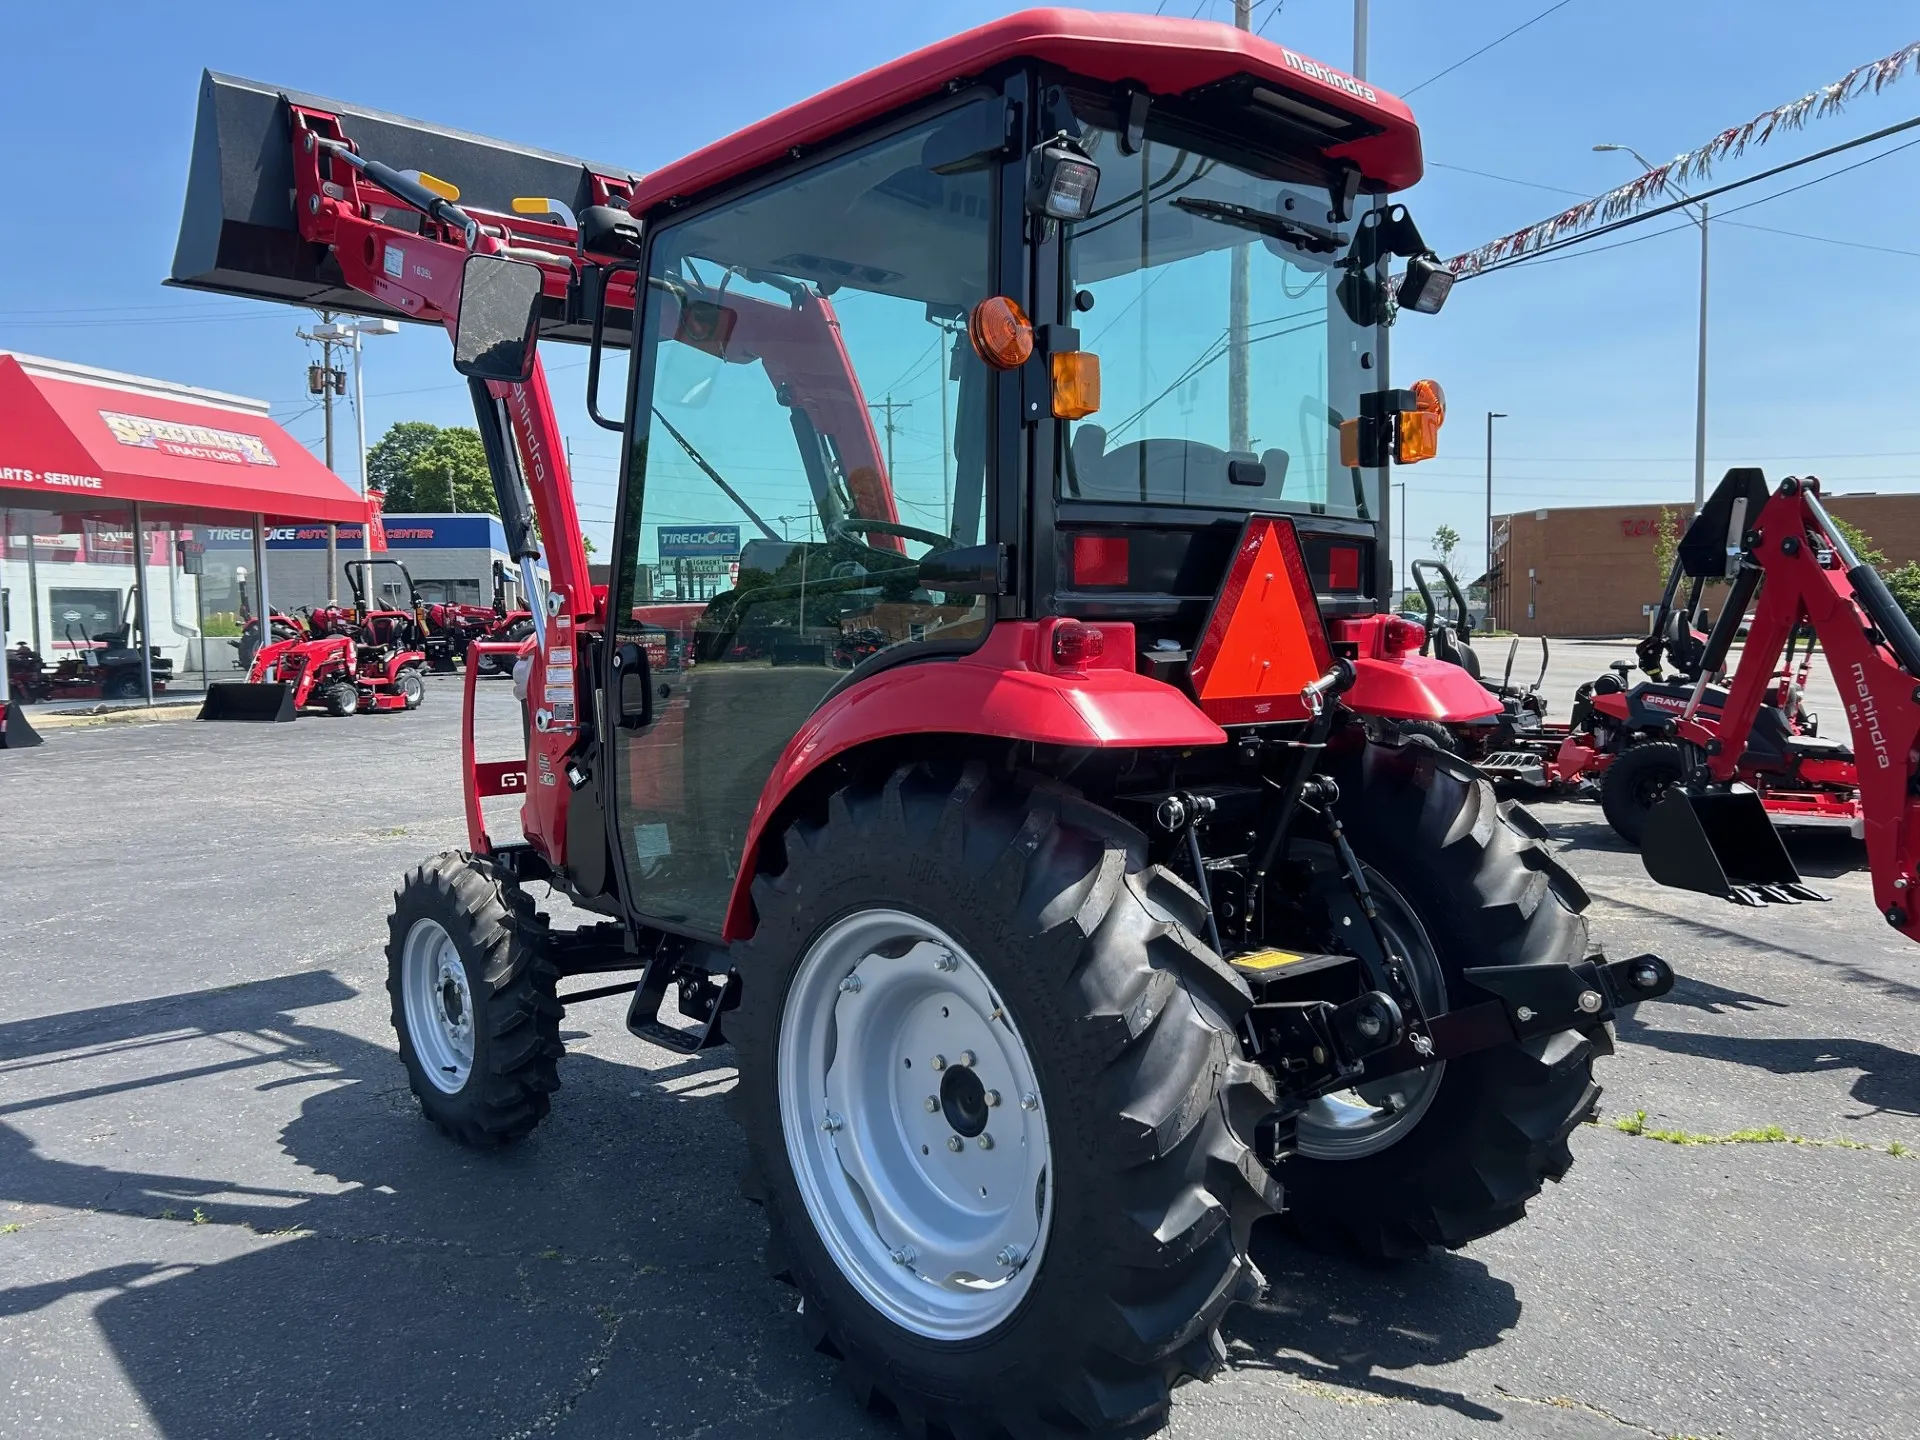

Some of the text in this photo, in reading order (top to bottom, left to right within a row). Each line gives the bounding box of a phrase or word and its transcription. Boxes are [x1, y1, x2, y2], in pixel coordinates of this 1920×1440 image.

[106, 415, 269, 463] SPECIALTY
[513, 382, 545, 482] ahindra
[162, 443, 242, 463] TRACTORS
[0, 467, 103, 489] RTS SERVICE
[386, 529, 434, 539] CENTER
[1646, 695, 1690, 709] GRAVE
[1851, 662, 1889, 769] mahindra
